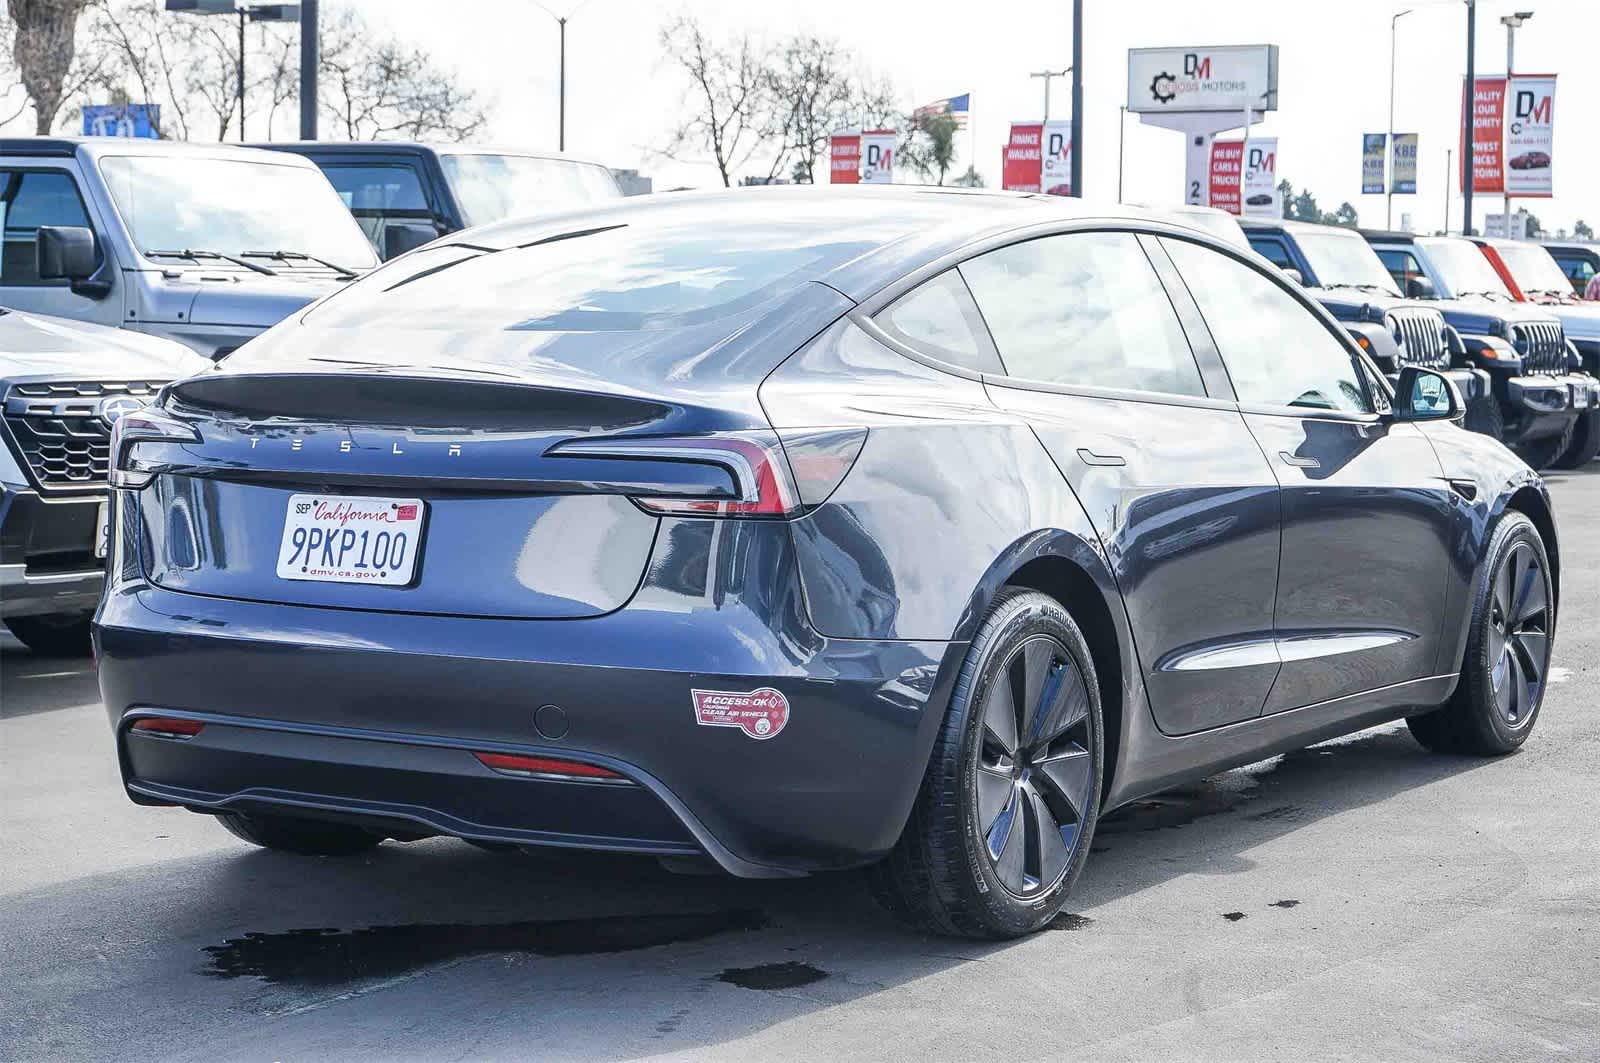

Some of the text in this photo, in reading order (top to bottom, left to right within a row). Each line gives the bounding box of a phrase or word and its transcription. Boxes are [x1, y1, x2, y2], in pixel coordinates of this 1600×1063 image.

[1184, 53, 1211, 79] DM
[1202, 80, 1246, 92] MOTORS
[1516, 91, 1551, 124] DM
[1213, 161, 1232, 172] CARS
[1212, 175, 1239, 185] TRUCKS
[1191, 181, 1200, 198] 2
[250, 437, 462, 457] TESLA
[296, 503, 312, 514] SEP
[314, 501, 396, 527] California
[288, 527, 407, 570] 9PKP100
[310, 568, 378, 578] dmv.ca.gov
[703, 696, 770, 706] ACCESS OK
[702, 708, 726, 716] CLEAN
[741, 710, 769, 718] VEHICLE
